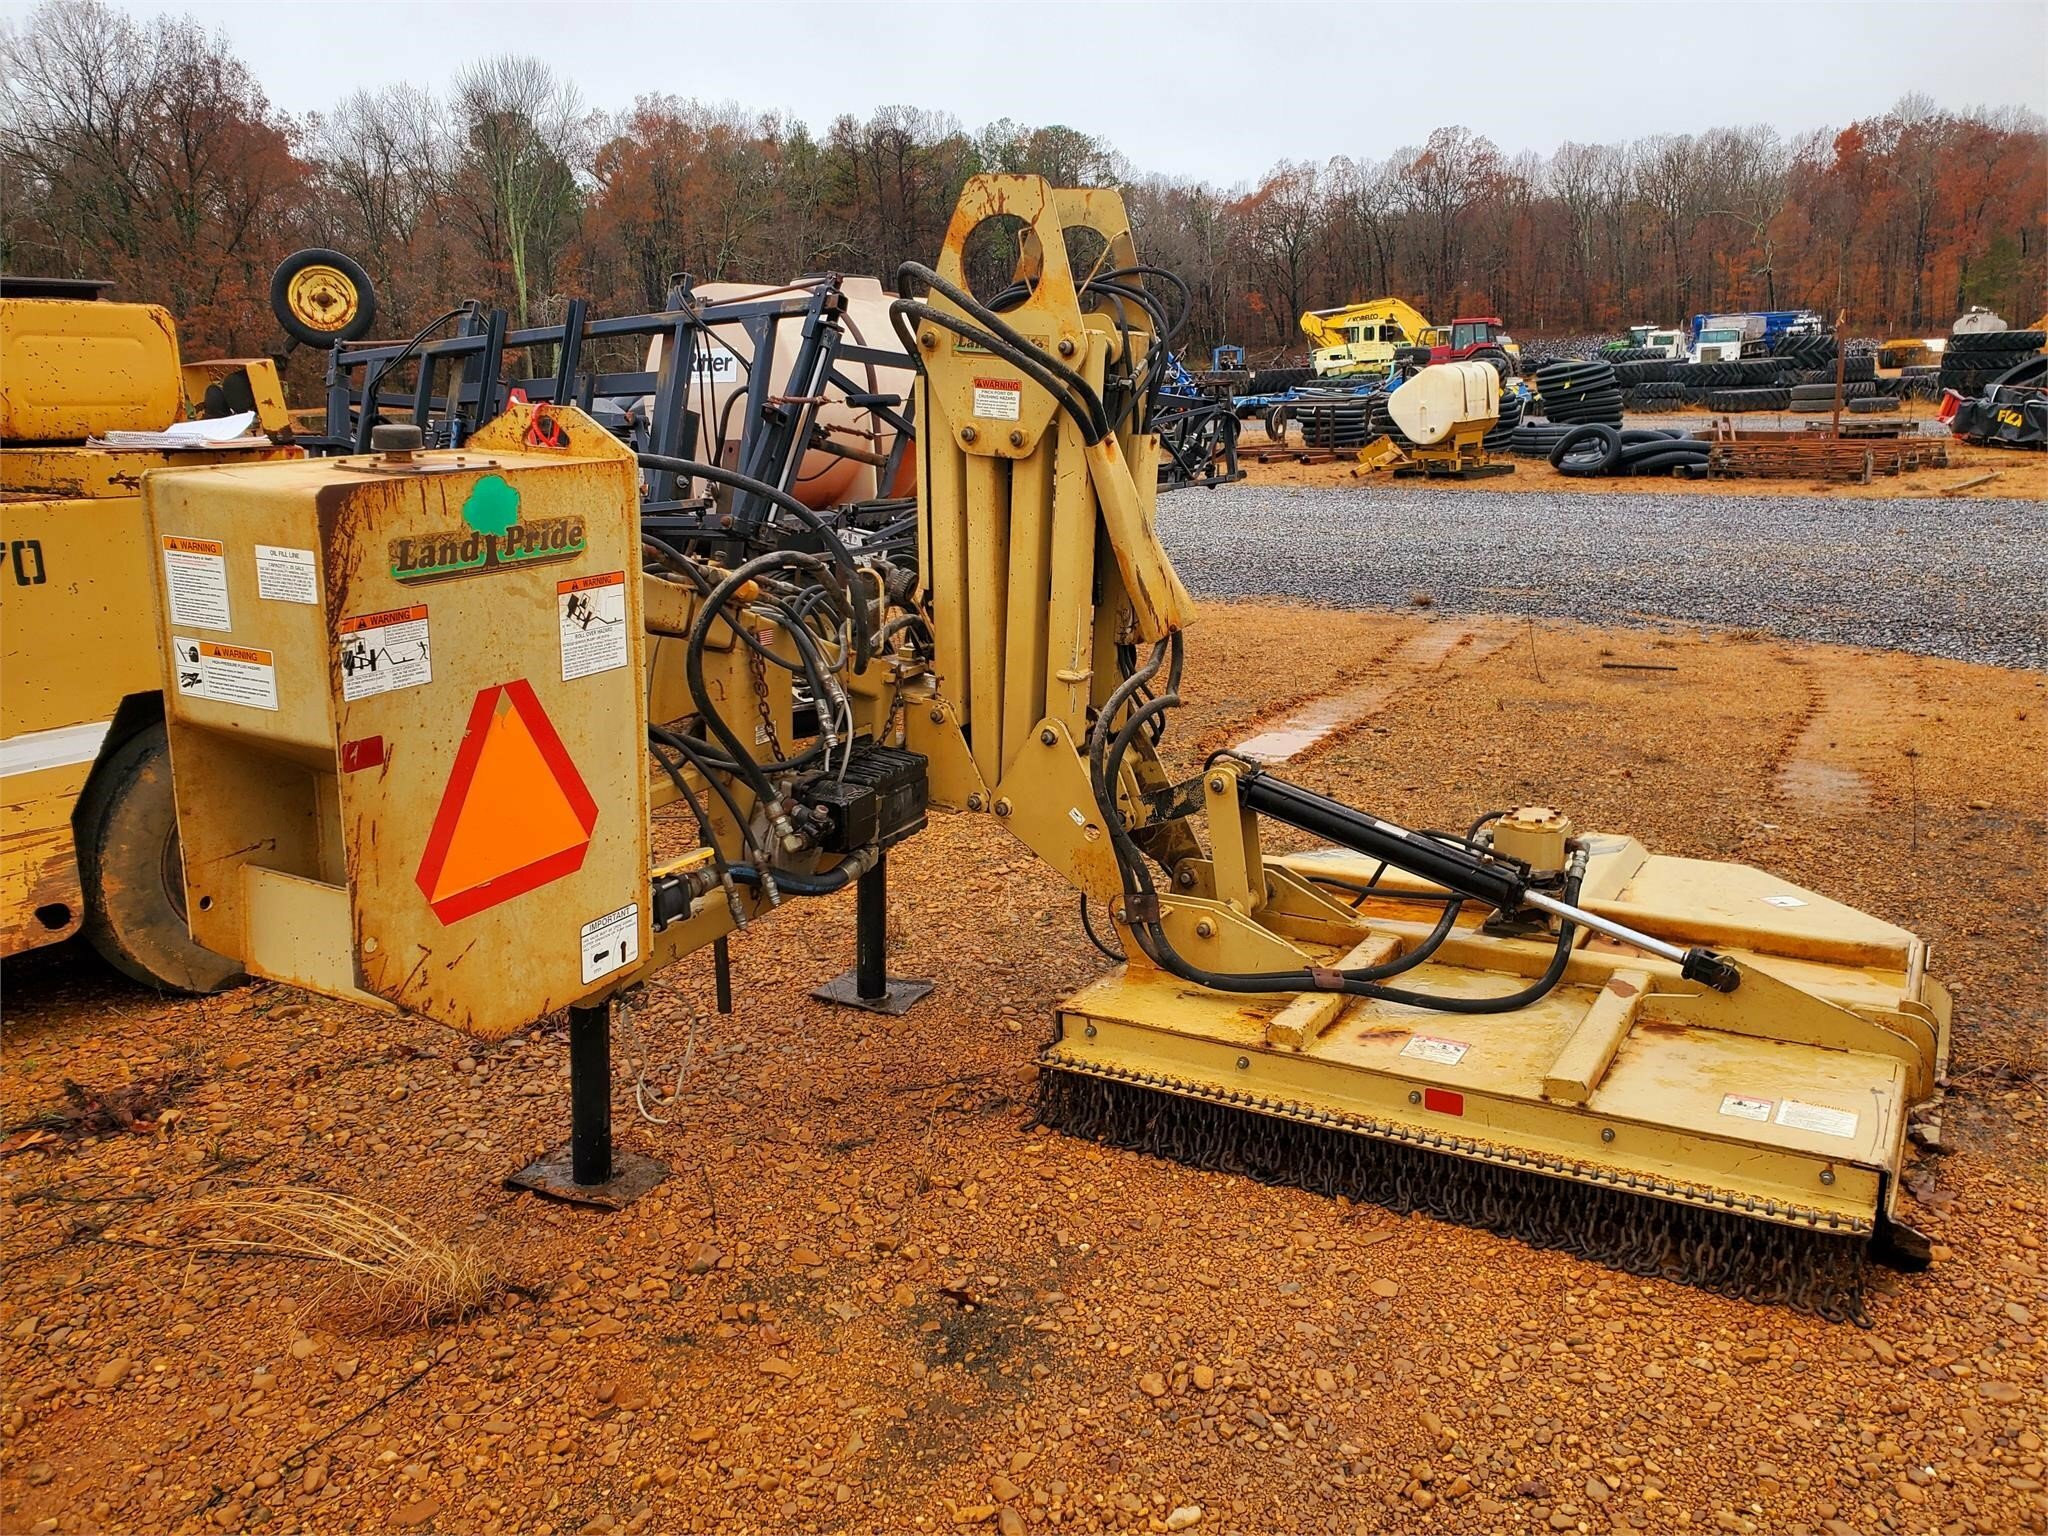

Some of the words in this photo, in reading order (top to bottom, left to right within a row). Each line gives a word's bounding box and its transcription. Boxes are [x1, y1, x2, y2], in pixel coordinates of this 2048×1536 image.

[982, 380, 1019, 390] WARNING
[180, 541, 217, 553] WARNING
[396, 531, 481, 571] Land
[504, 519, 583, 556] Pride
[289, 551, 300, 559] LINE
[582, 576, 612, 588] WARNING
[370, 610, 411, 626] WARNING
[222, 646, 258, 662] WARNING
[589, 907, 630, 932] IMPORTANT
